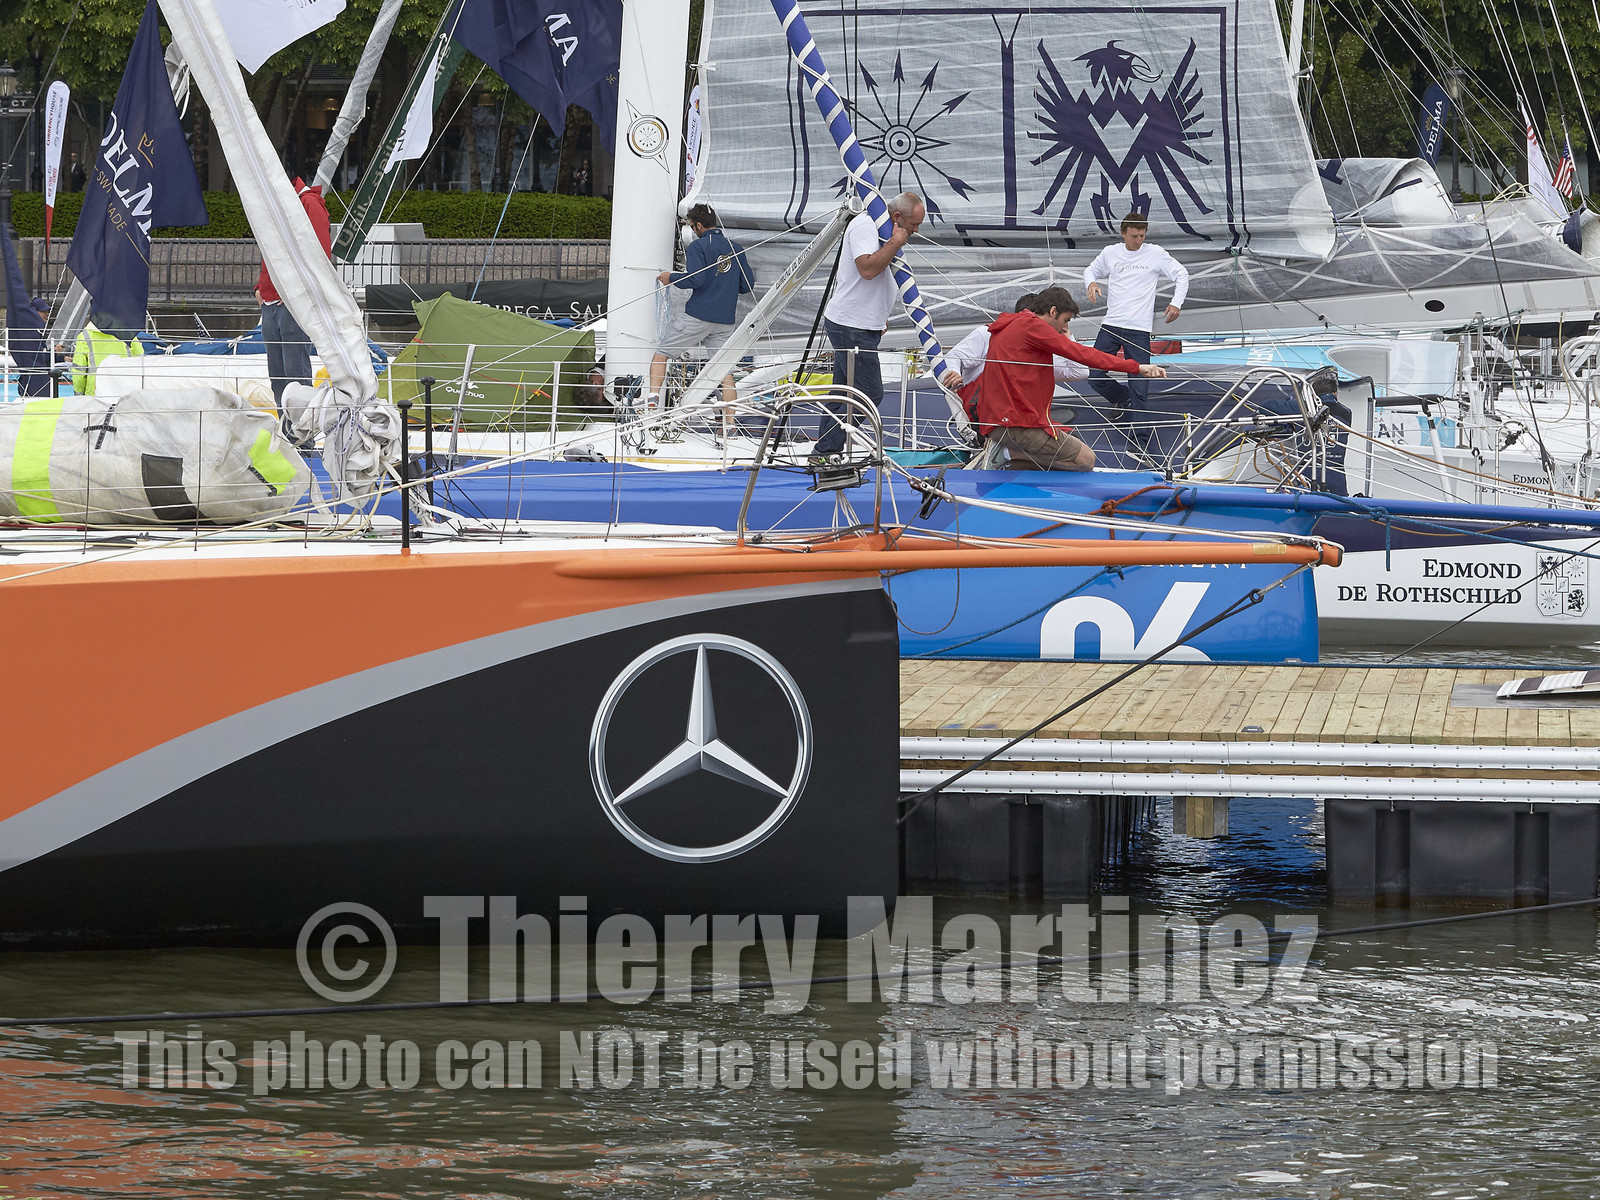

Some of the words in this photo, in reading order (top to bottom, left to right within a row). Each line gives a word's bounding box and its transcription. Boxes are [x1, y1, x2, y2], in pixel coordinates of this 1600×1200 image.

[1426, 100, 1443, 156] DELMA
[1513, 474, 1557, 486] EDMON
[1422, 558, 1522, 579] EDMOND
[1337, 585, 1367, 601] DE
[1376, 583, 1522, 604] ROTHSCHILD
